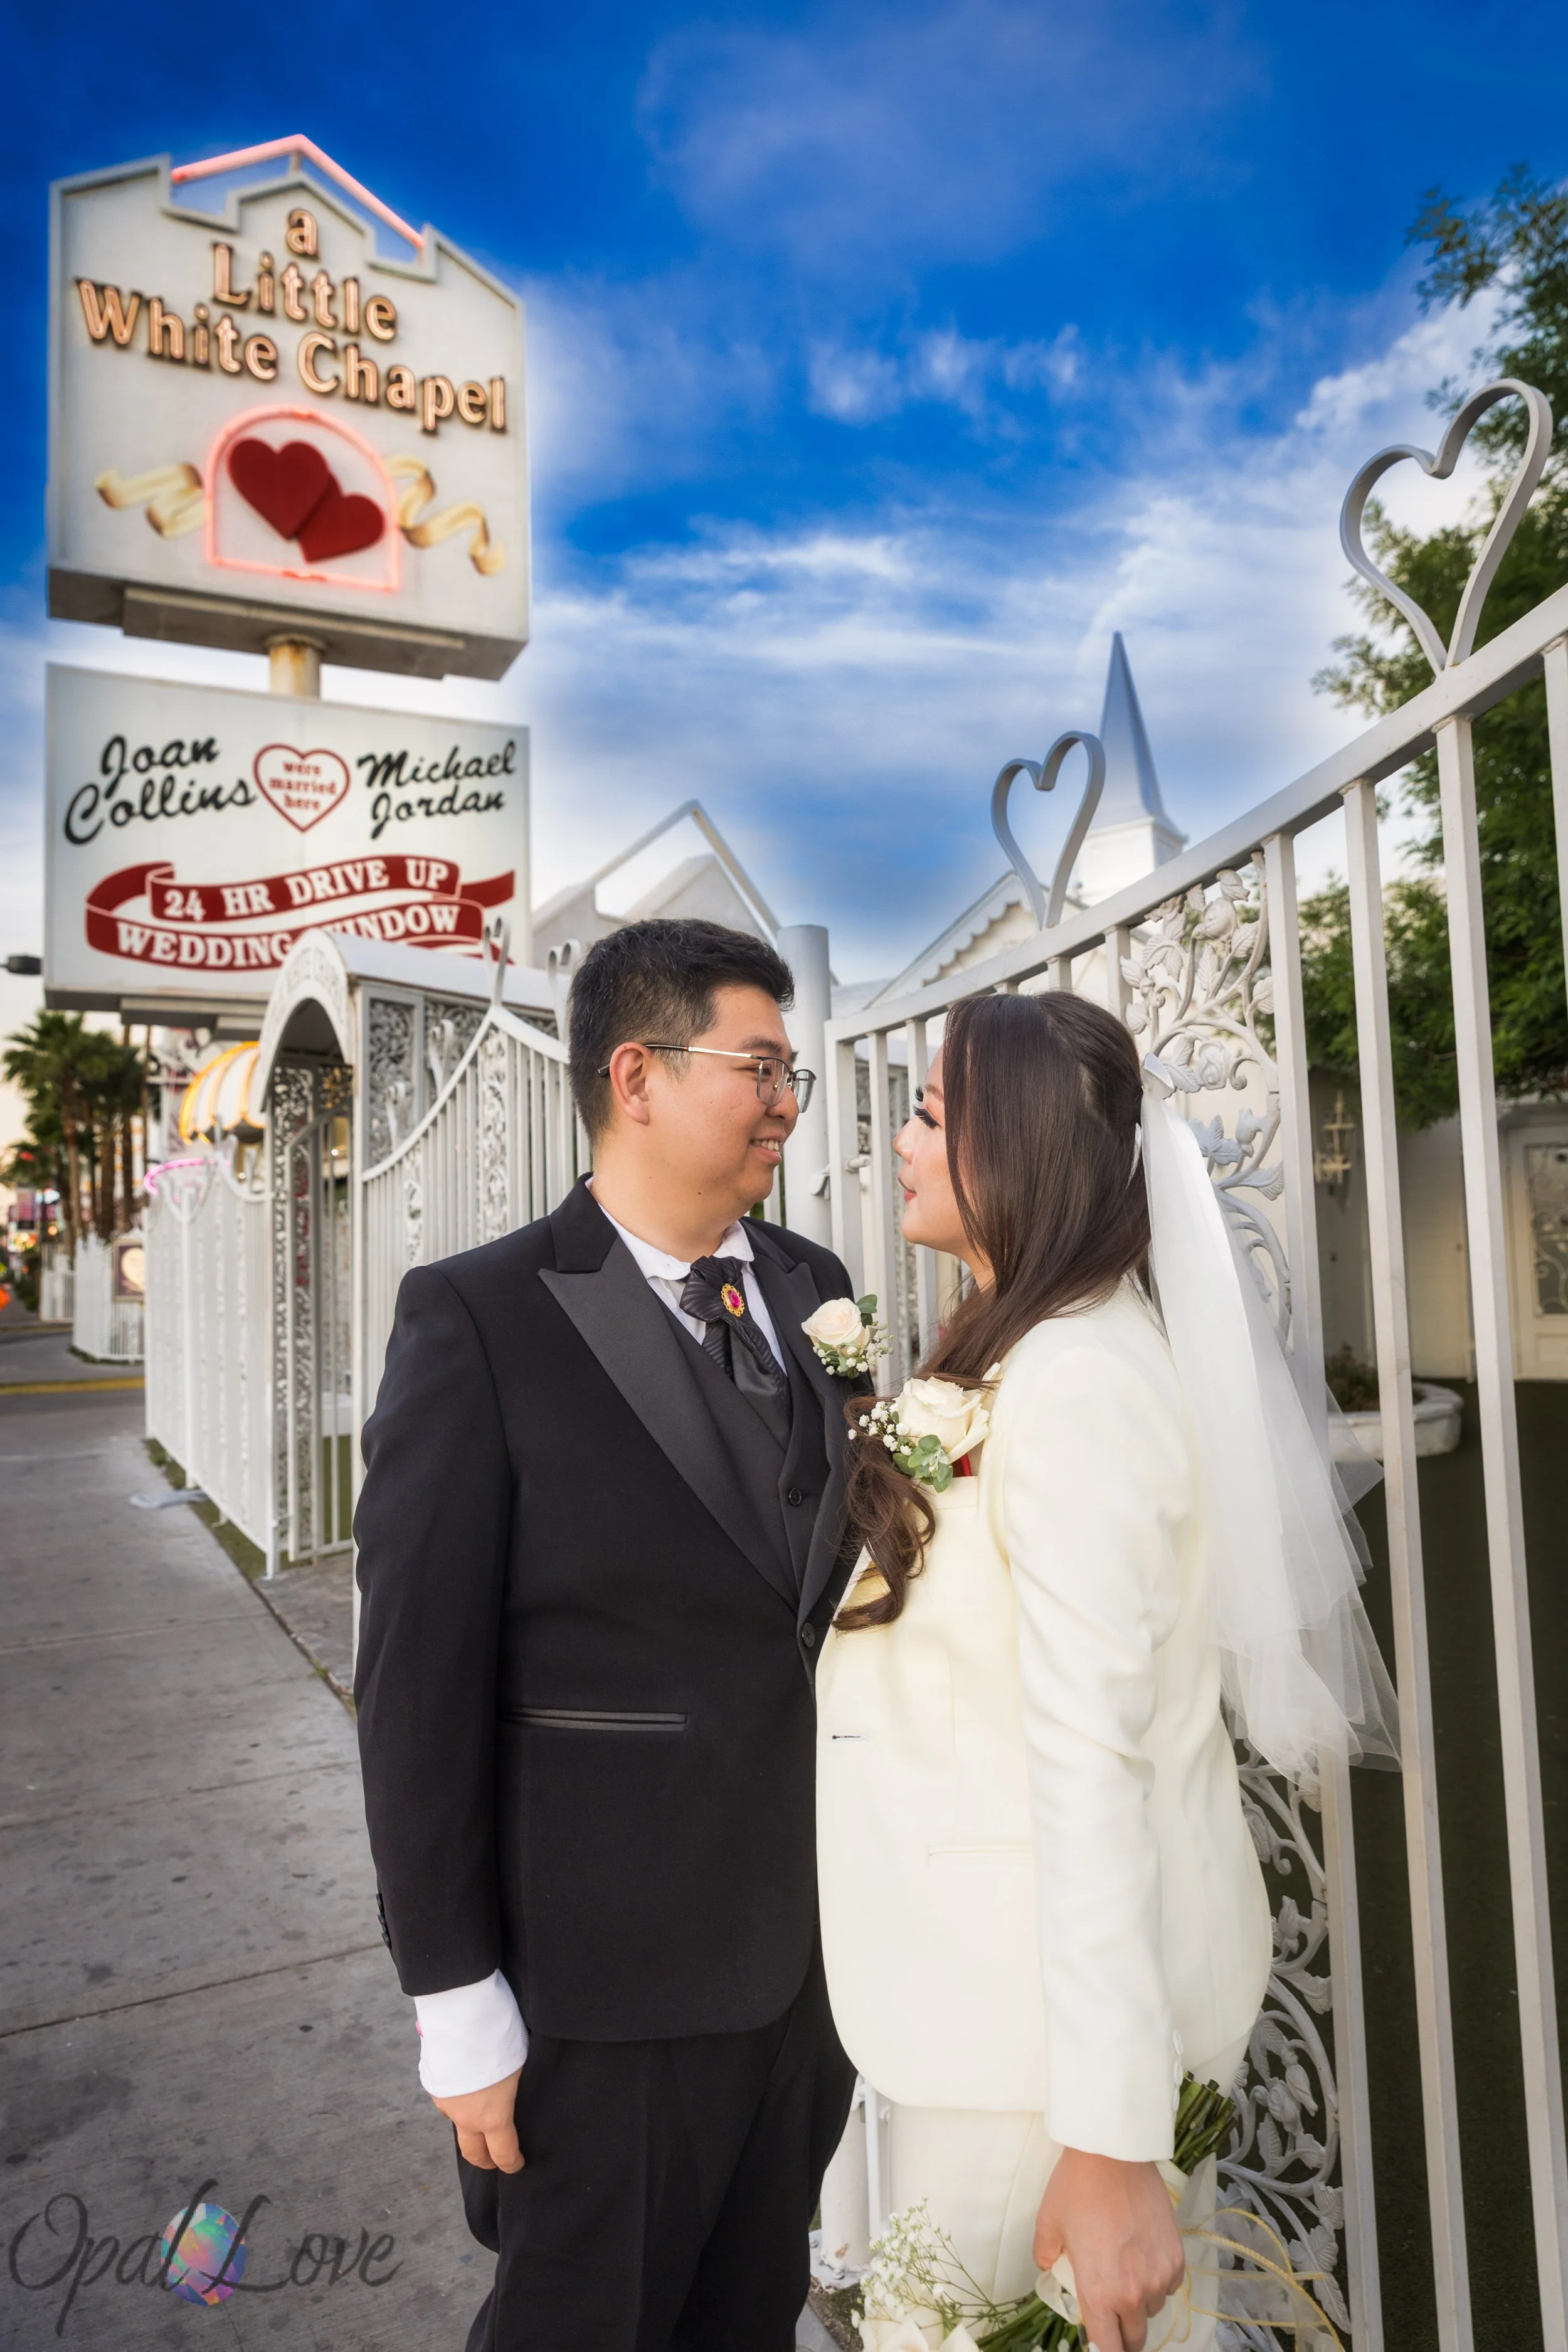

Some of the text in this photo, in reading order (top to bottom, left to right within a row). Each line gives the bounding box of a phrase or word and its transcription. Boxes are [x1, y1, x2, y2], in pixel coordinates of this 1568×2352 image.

[285, 208, 319, 258] a
[212, 241, 398, 342] Little
[75, 278, 508, 436] White Chapel
[100, 734, 220, 799] Joan
[269, 777, 336, 795] married
[283, 761, 320, 776] were
[357, 739, 516, 787] Michael
[65, 774, 257, 845] Collins
[283, 793, 320, 810] here
[370, 783, 504, 840] Jordan
[163, 857, 448, 922] 24 HR DRIVE UP
[325, 904, 460, 940] INDOW
